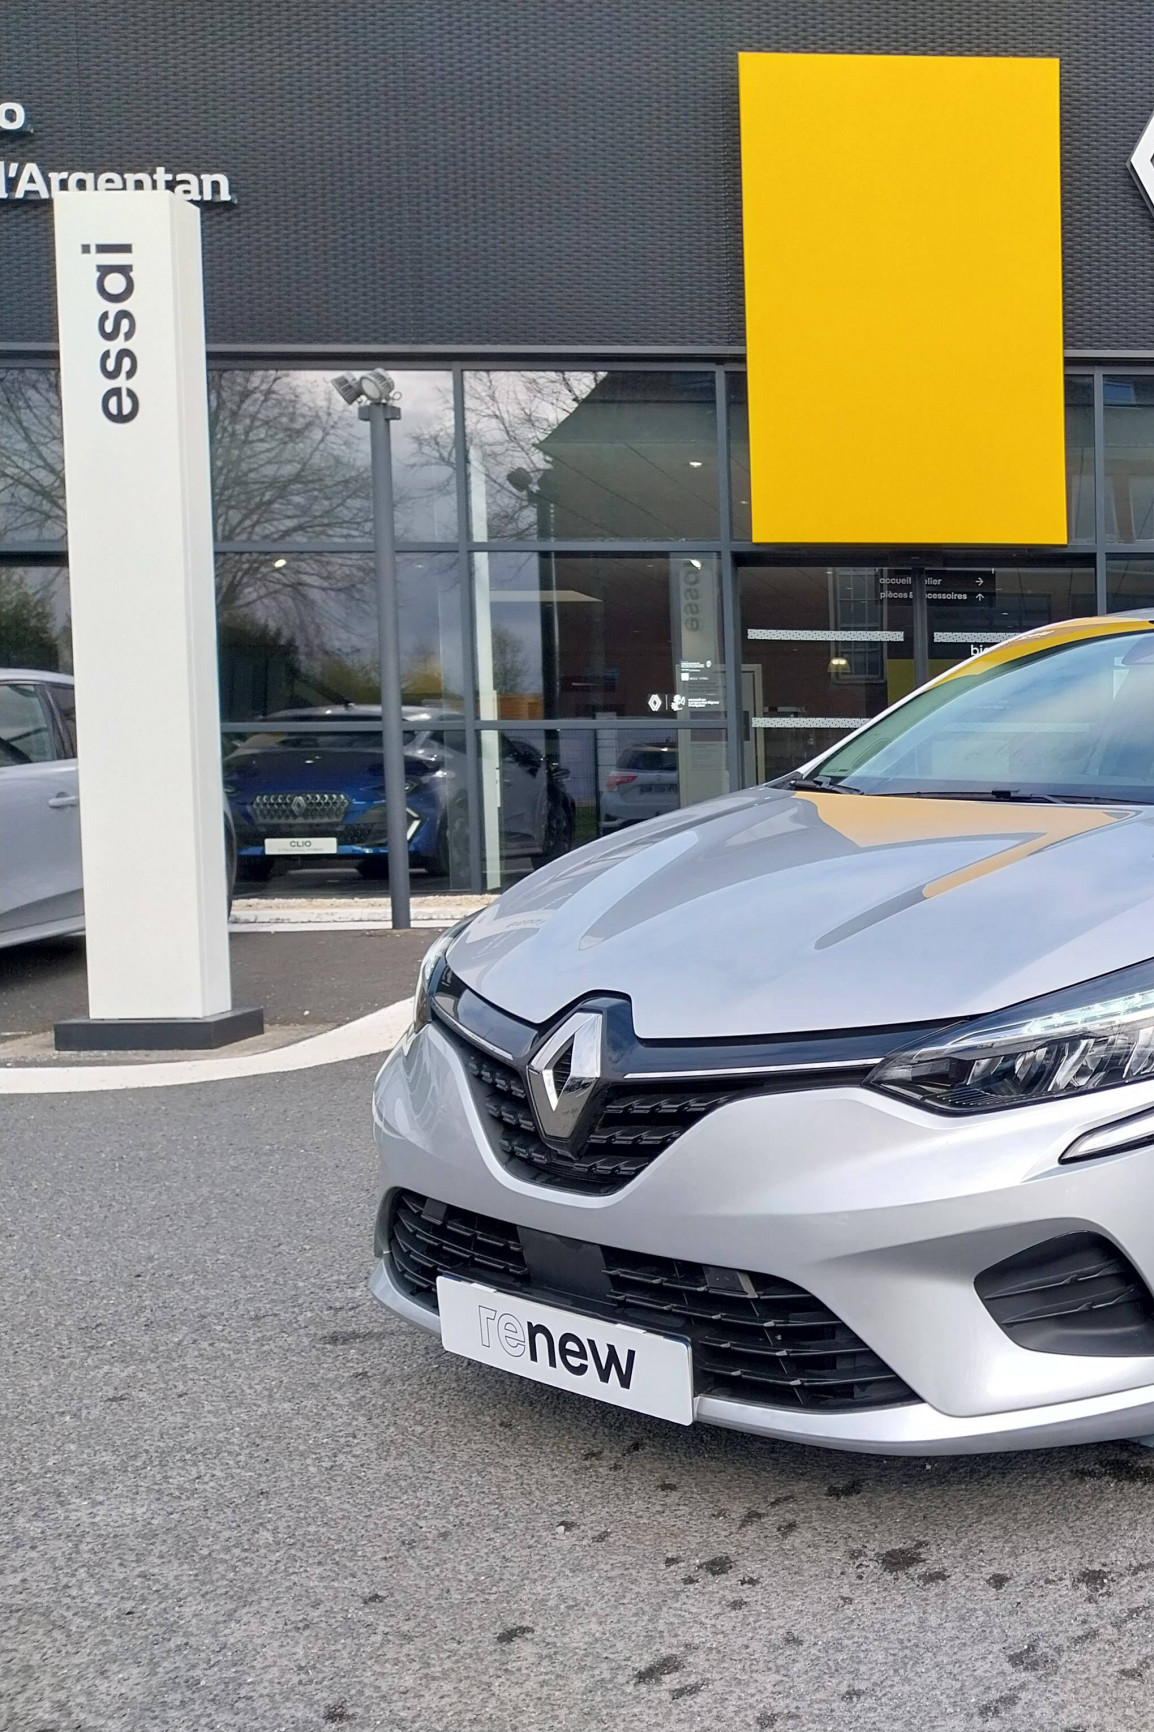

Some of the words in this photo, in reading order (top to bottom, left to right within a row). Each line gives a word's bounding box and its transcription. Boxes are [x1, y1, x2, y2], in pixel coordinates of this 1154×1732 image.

[81, 243, 140, 424] essai
[879, 576, 912, 585] accueil
[925, 577, 942, 585] lier
[880, 590, 908, 600] pièces
[925, 591, 968, 600] cessoires
[289, 840, 312, 848] CLIO
[478, 1304, 636, 1390] renew
